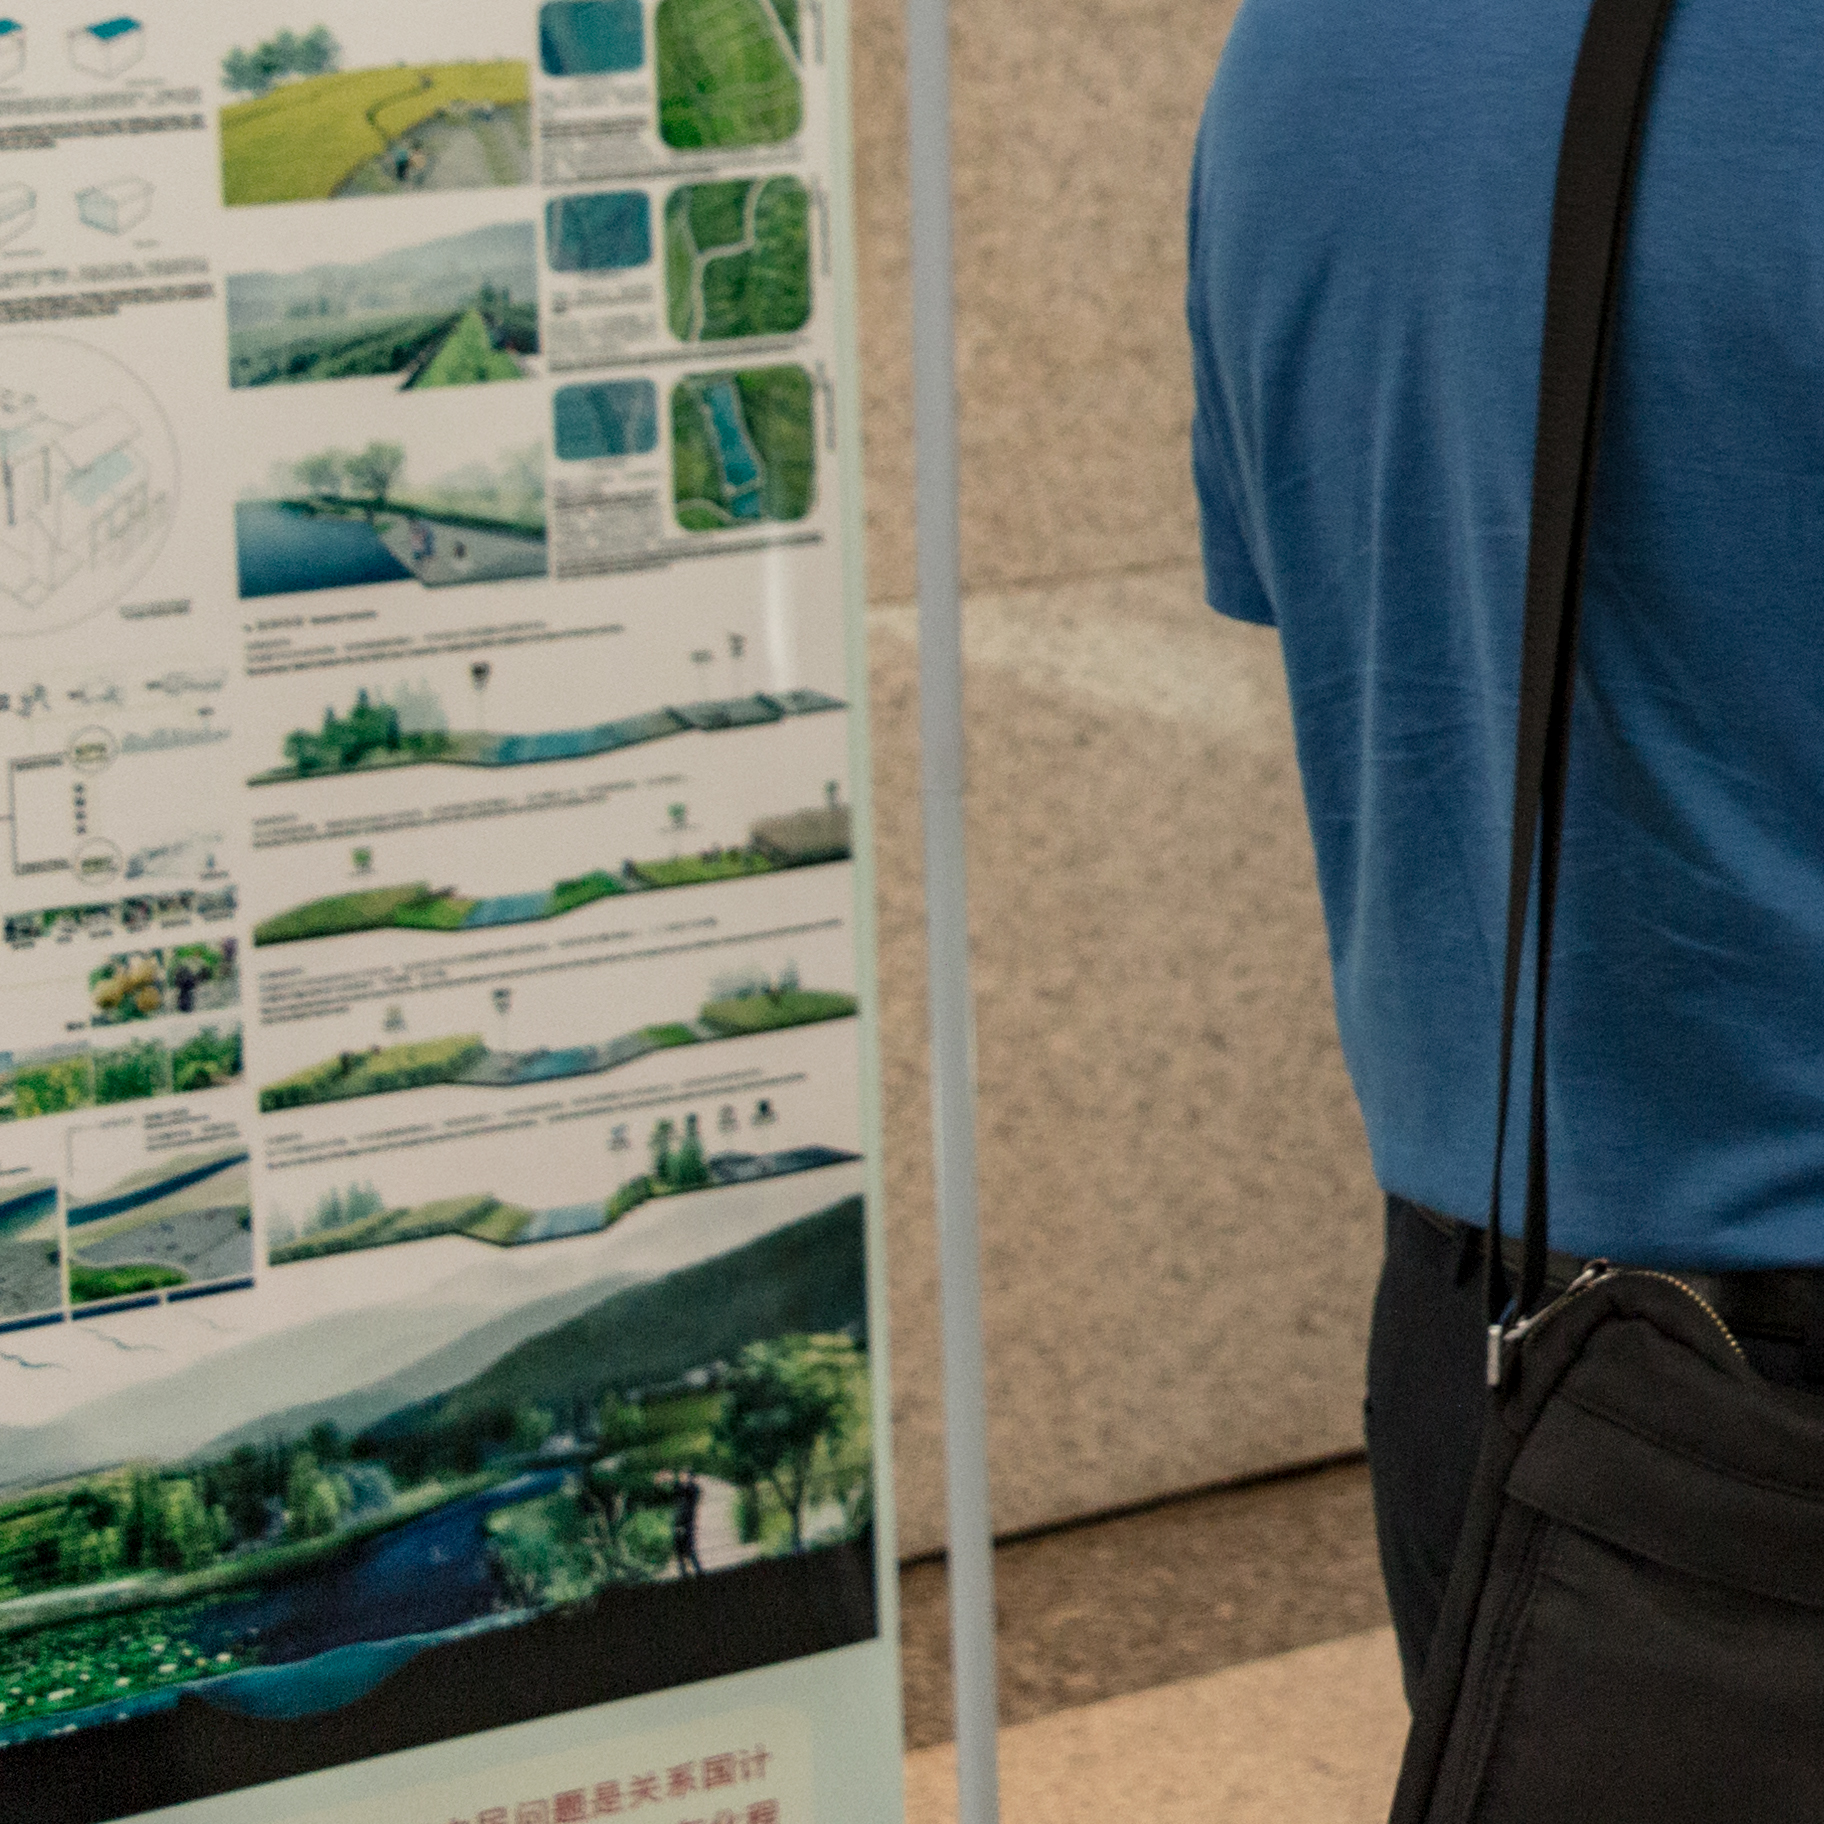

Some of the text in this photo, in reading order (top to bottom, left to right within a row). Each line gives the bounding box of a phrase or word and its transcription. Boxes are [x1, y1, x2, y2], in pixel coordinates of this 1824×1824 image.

[450, 1742, 773, 1824] 民问题是关系国计
